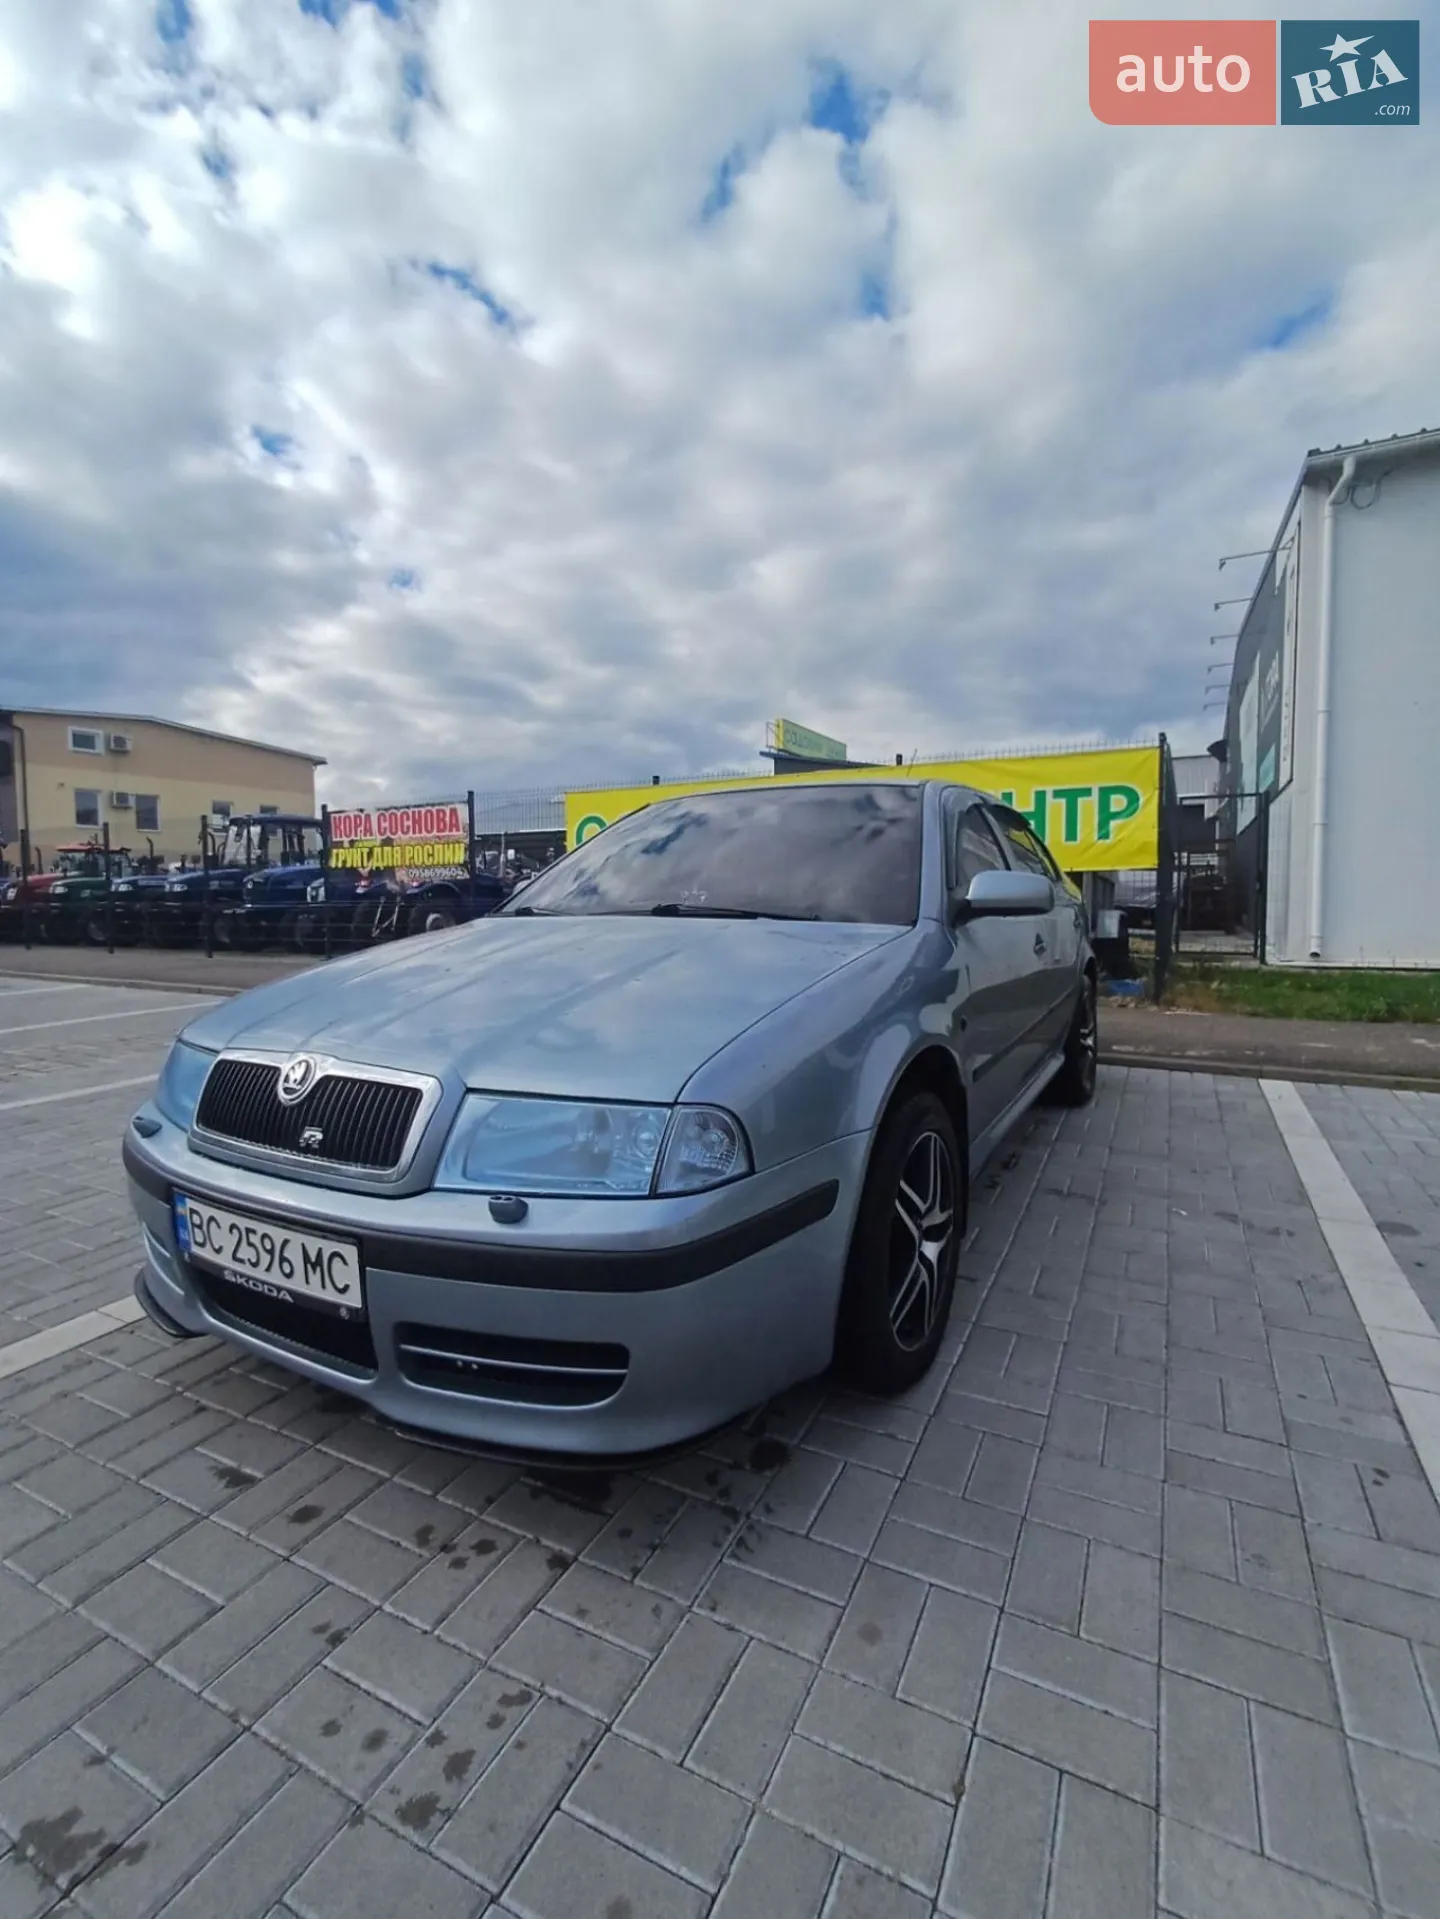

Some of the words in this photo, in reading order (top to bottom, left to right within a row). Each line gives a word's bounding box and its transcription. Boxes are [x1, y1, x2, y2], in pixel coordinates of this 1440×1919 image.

[332, 813, 373, 839] КОРА
[378, 807, 461, 836] СОСНОВА
[1001, 785, 1140, 844] НТР
[331, 847, 370, 868] ГРУНТ
[372, 845, 402, 869] ДЛЯ
[189, 1207, 223, 1255] BC
[229, 1222, 295, 1280] 2596
[302, 1242, 351, 1295] MC
